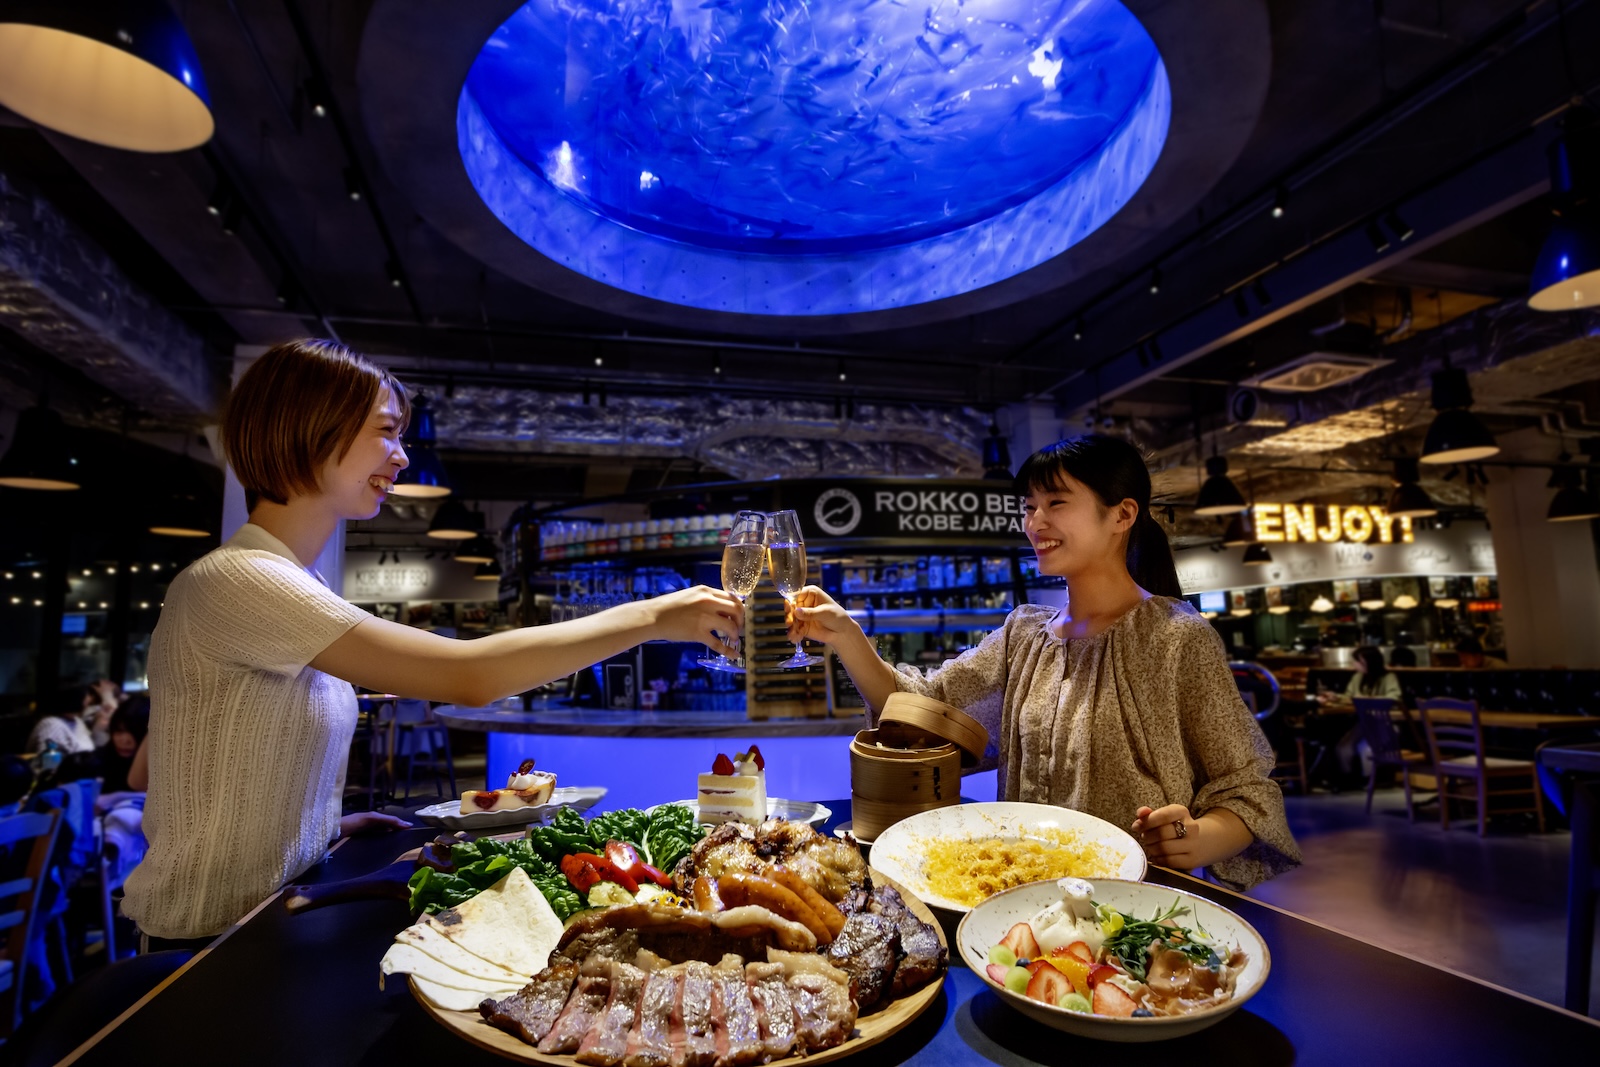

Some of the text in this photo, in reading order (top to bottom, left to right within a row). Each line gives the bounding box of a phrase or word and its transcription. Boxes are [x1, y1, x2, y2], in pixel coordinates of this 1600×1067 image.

[875, 491, 979, 513] ROKKO
[899, 514, 964, 531] KOBE
[1254, 502, 1415, 544] ENJOY!
